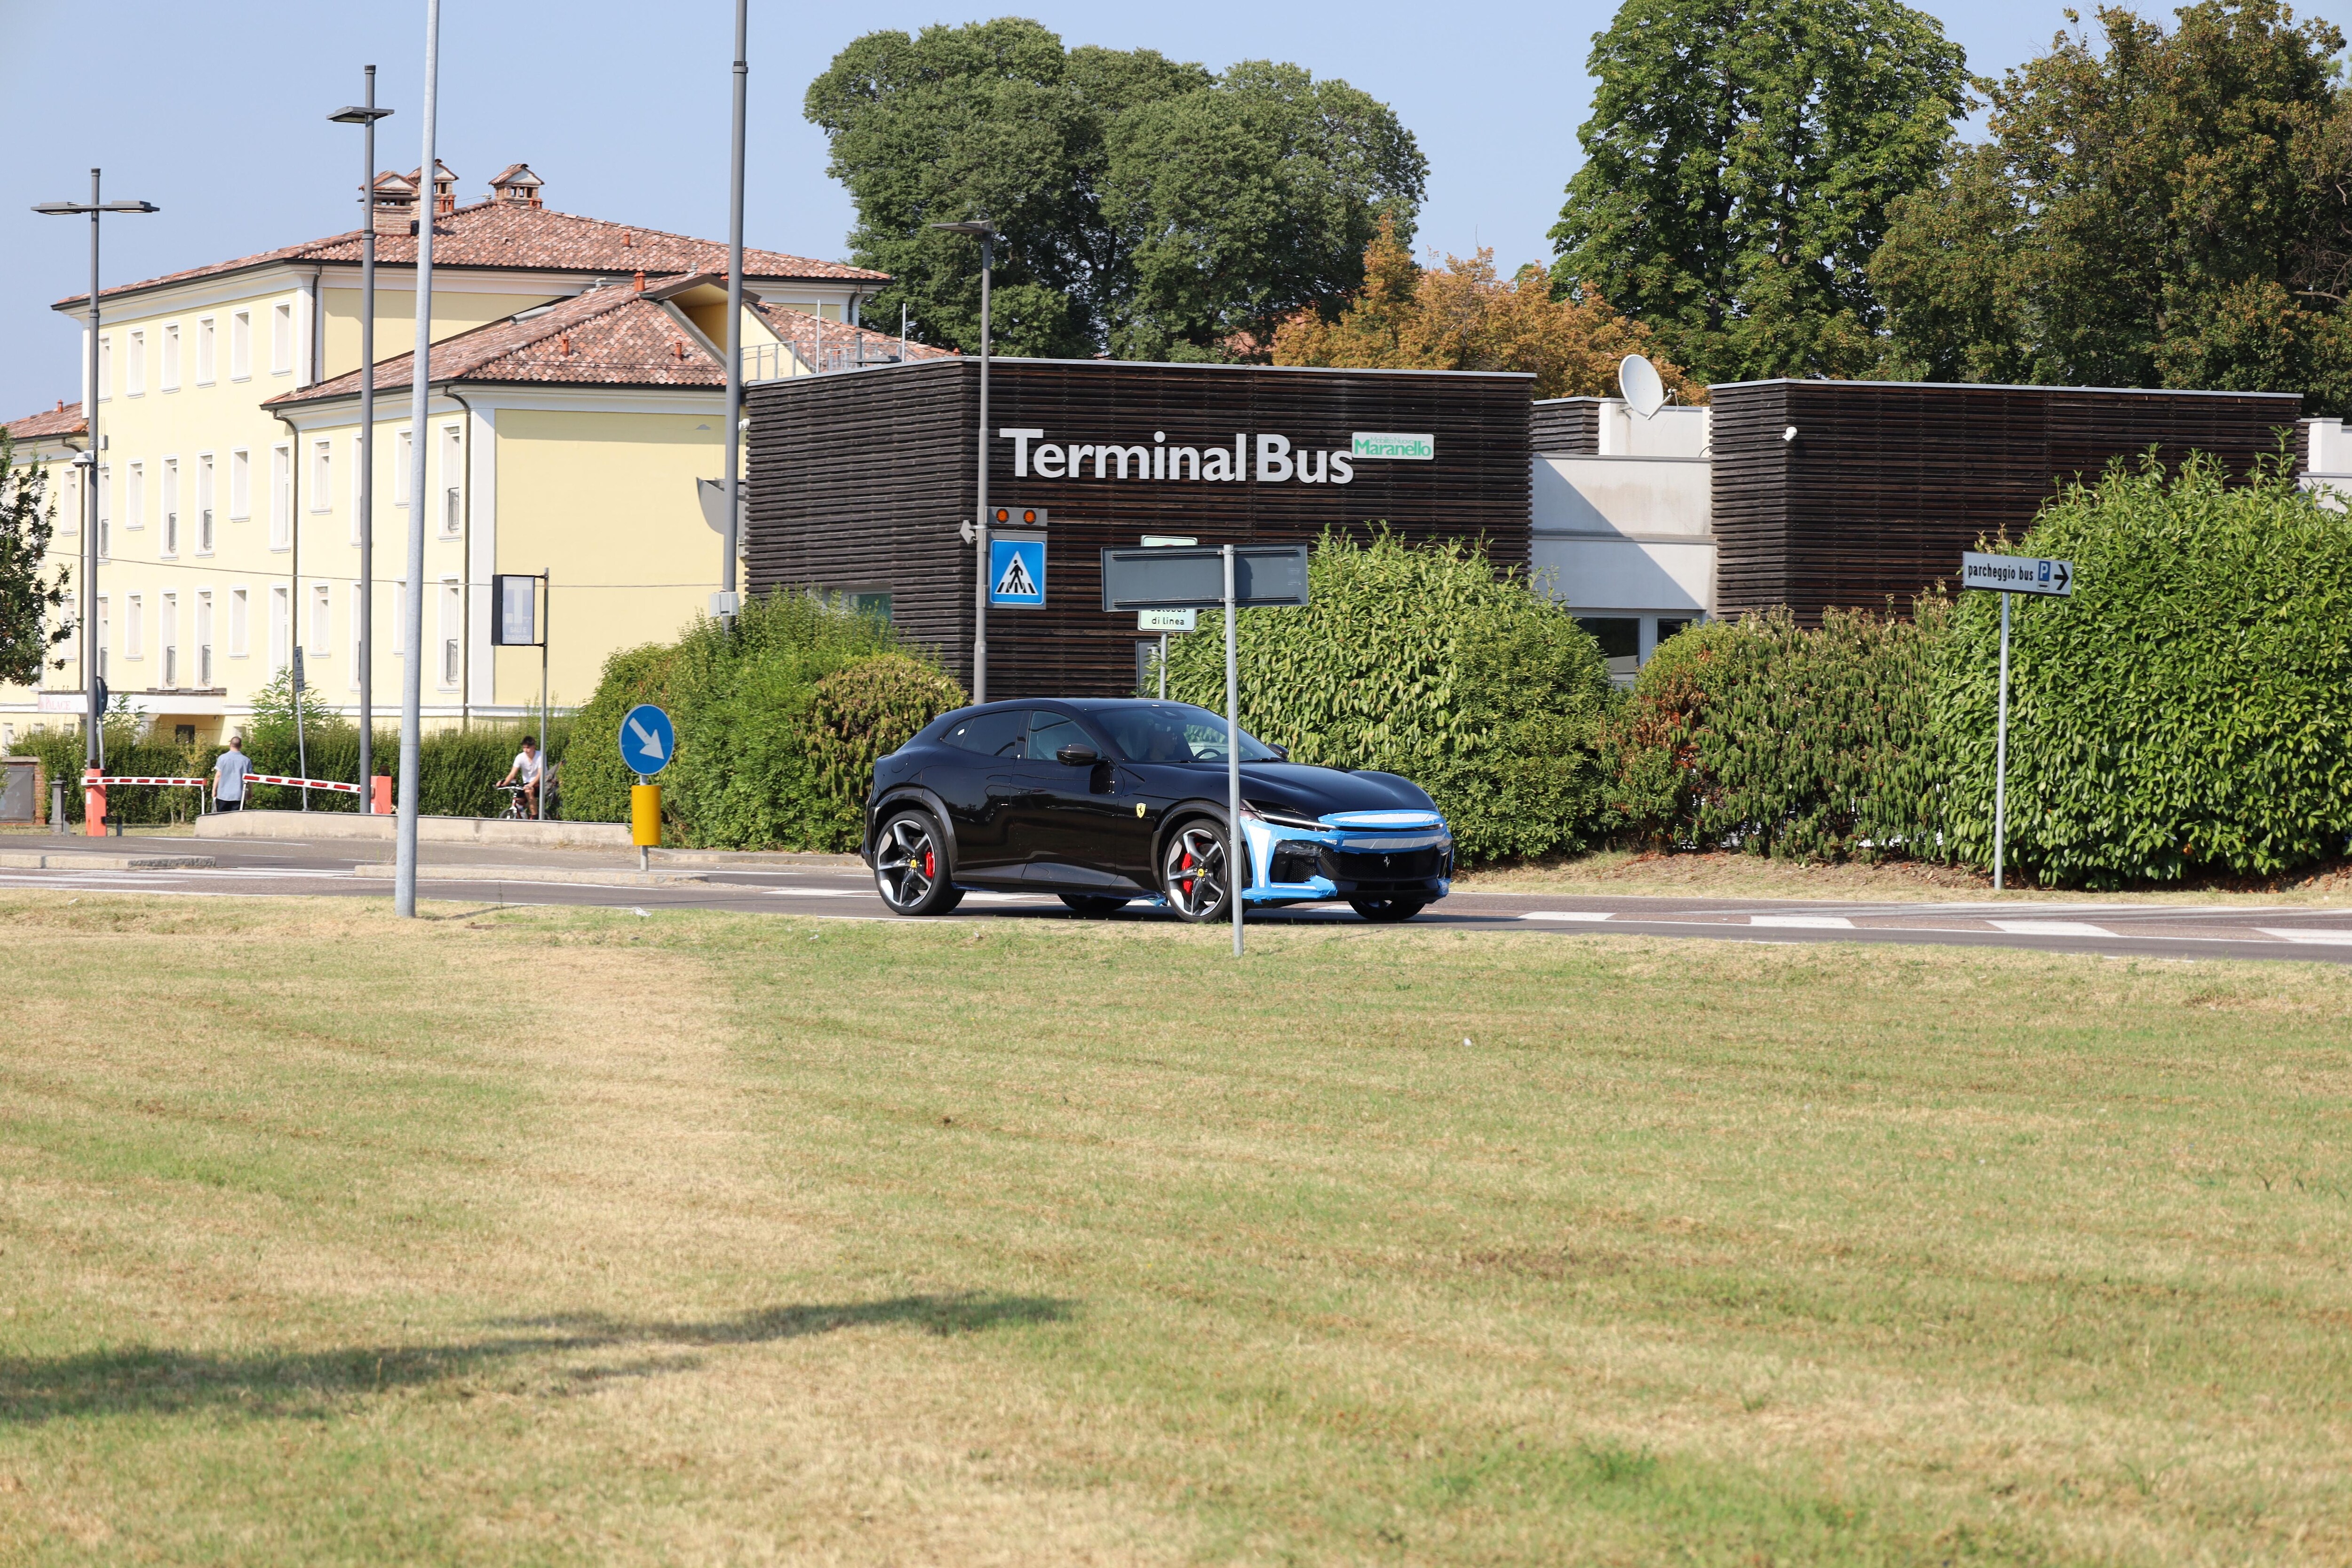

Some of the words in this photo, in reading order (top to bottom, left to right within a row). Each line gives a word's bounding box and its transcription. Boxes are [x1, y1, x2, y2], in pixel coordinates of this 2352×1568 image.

[1354, 438, 1431, 456] Maranello
[1968, 563, 2016, 581] parcheggio
[2019, 565, 2034, 581] bus
[2040, 563, 2049, 579] P
[505, 580, 532, 623] T
[1163, 617, 1184, 625] linea
